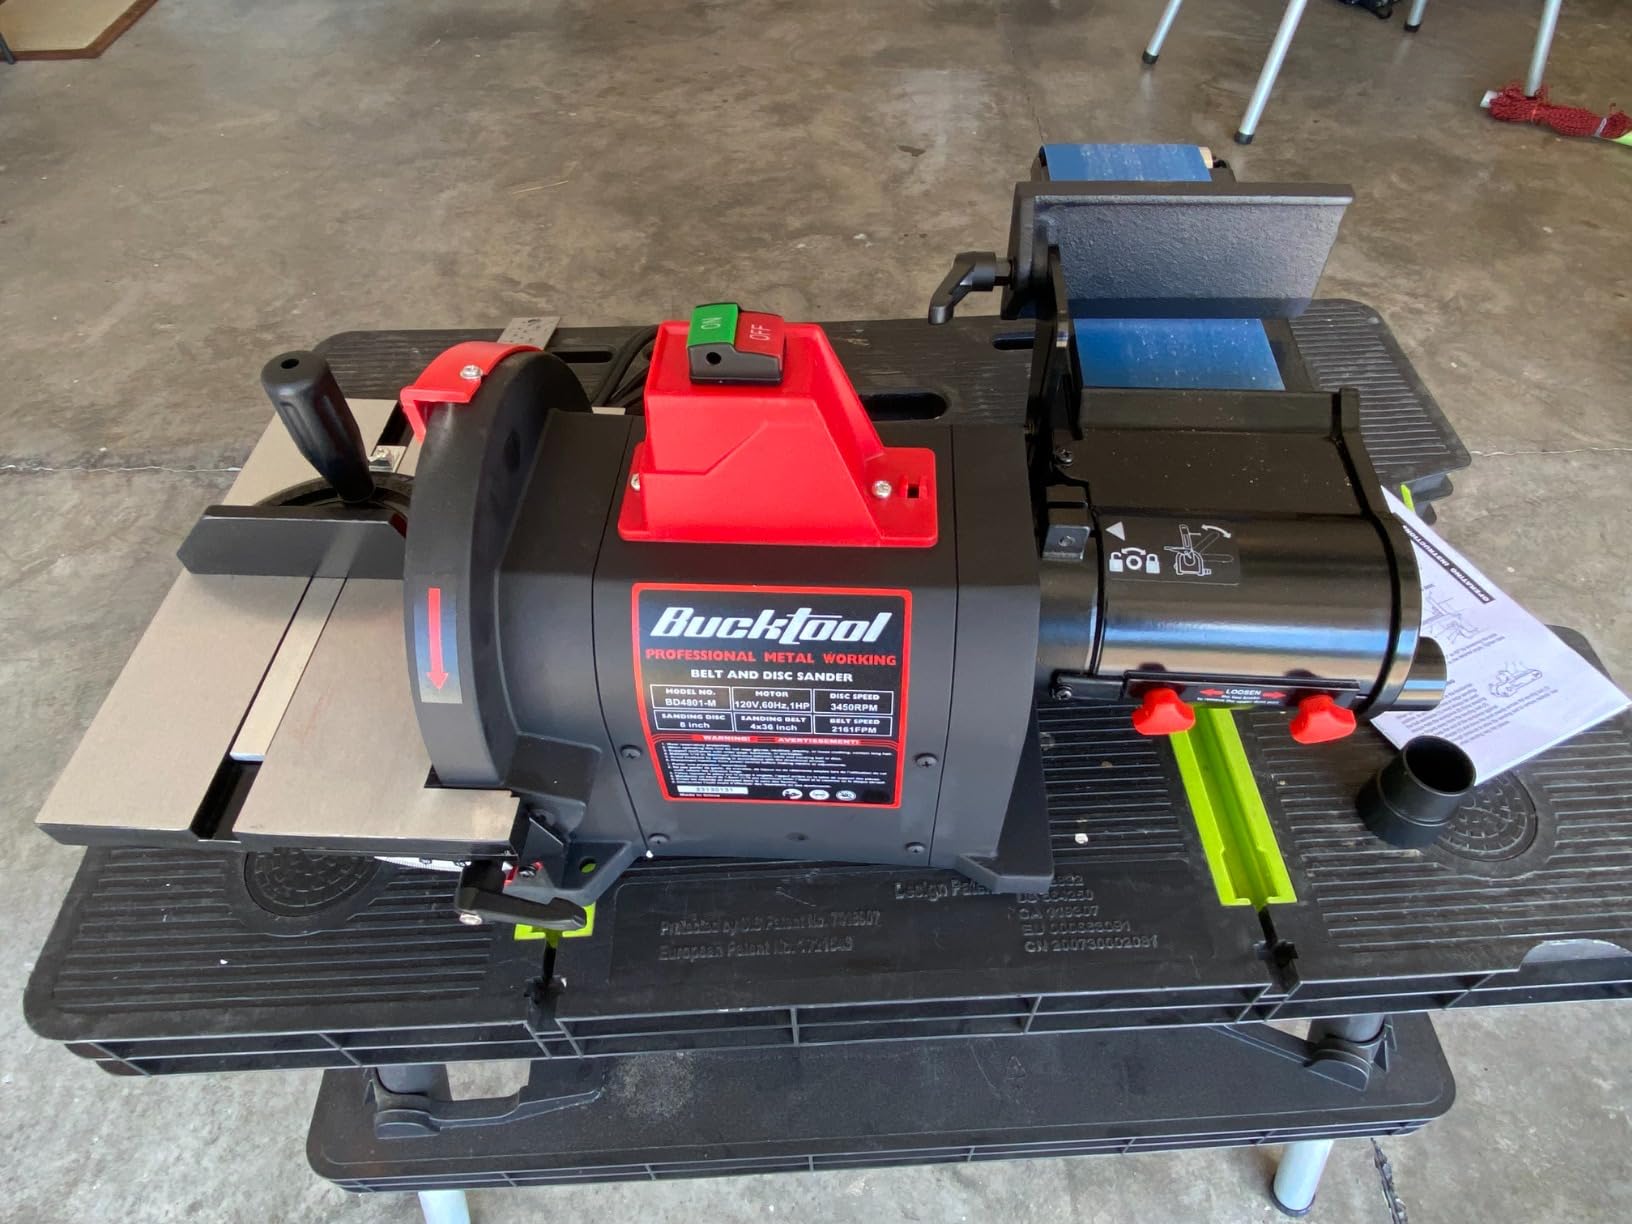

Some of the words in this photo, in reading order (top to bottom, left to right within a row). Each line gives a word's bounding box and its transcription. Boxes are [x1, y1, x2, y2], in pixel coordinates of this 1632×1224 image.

[700, 316, 722, 330] ON
[749, 324, 772, 341] OFF
[1450, 567, 1490, 602] OPERATING
[650, 607, 893, 645] Bucktool
[645, 648, 757, 662] PROFESSIONAL
[763, 651, 815, 664] METAL
[823, 652, 897, 666] WORKING
[690, 669, 723, 679] BELT
[727, 670, 759, 680] AND
[762, 671, 793, 681] DISC
[797, 672, 854, 682] SANDER
[665, 687, 697, 696] MODEL
[755, 690, 789, 699] MOTOR
[1225, 688, 1262, 696] LOOSEN
[829, 692, 851, 700] DISC
[852, 693, 880, 701] SPEED
[664, 697, 717, 708] BD4801-M
[734, 700, 810, 711] 120V,60Hz,1HP
[830, 703, 879, 712] 3450RPM
[661, 713, 704, 721] SANDING
[740, 715, 783, 723] SANDING
[688, 721, 711, 729] inch
[853, 718, 881, 726] SPEED
[750, 723, 774, 731] 4x36
[775, 723, 798, 732] inch
[831, 726, 878, 734] 2161FPM
[703, 735, 751, 743] WARNING!
[777, 737, 860, 746] AVERTISSEMENT!
